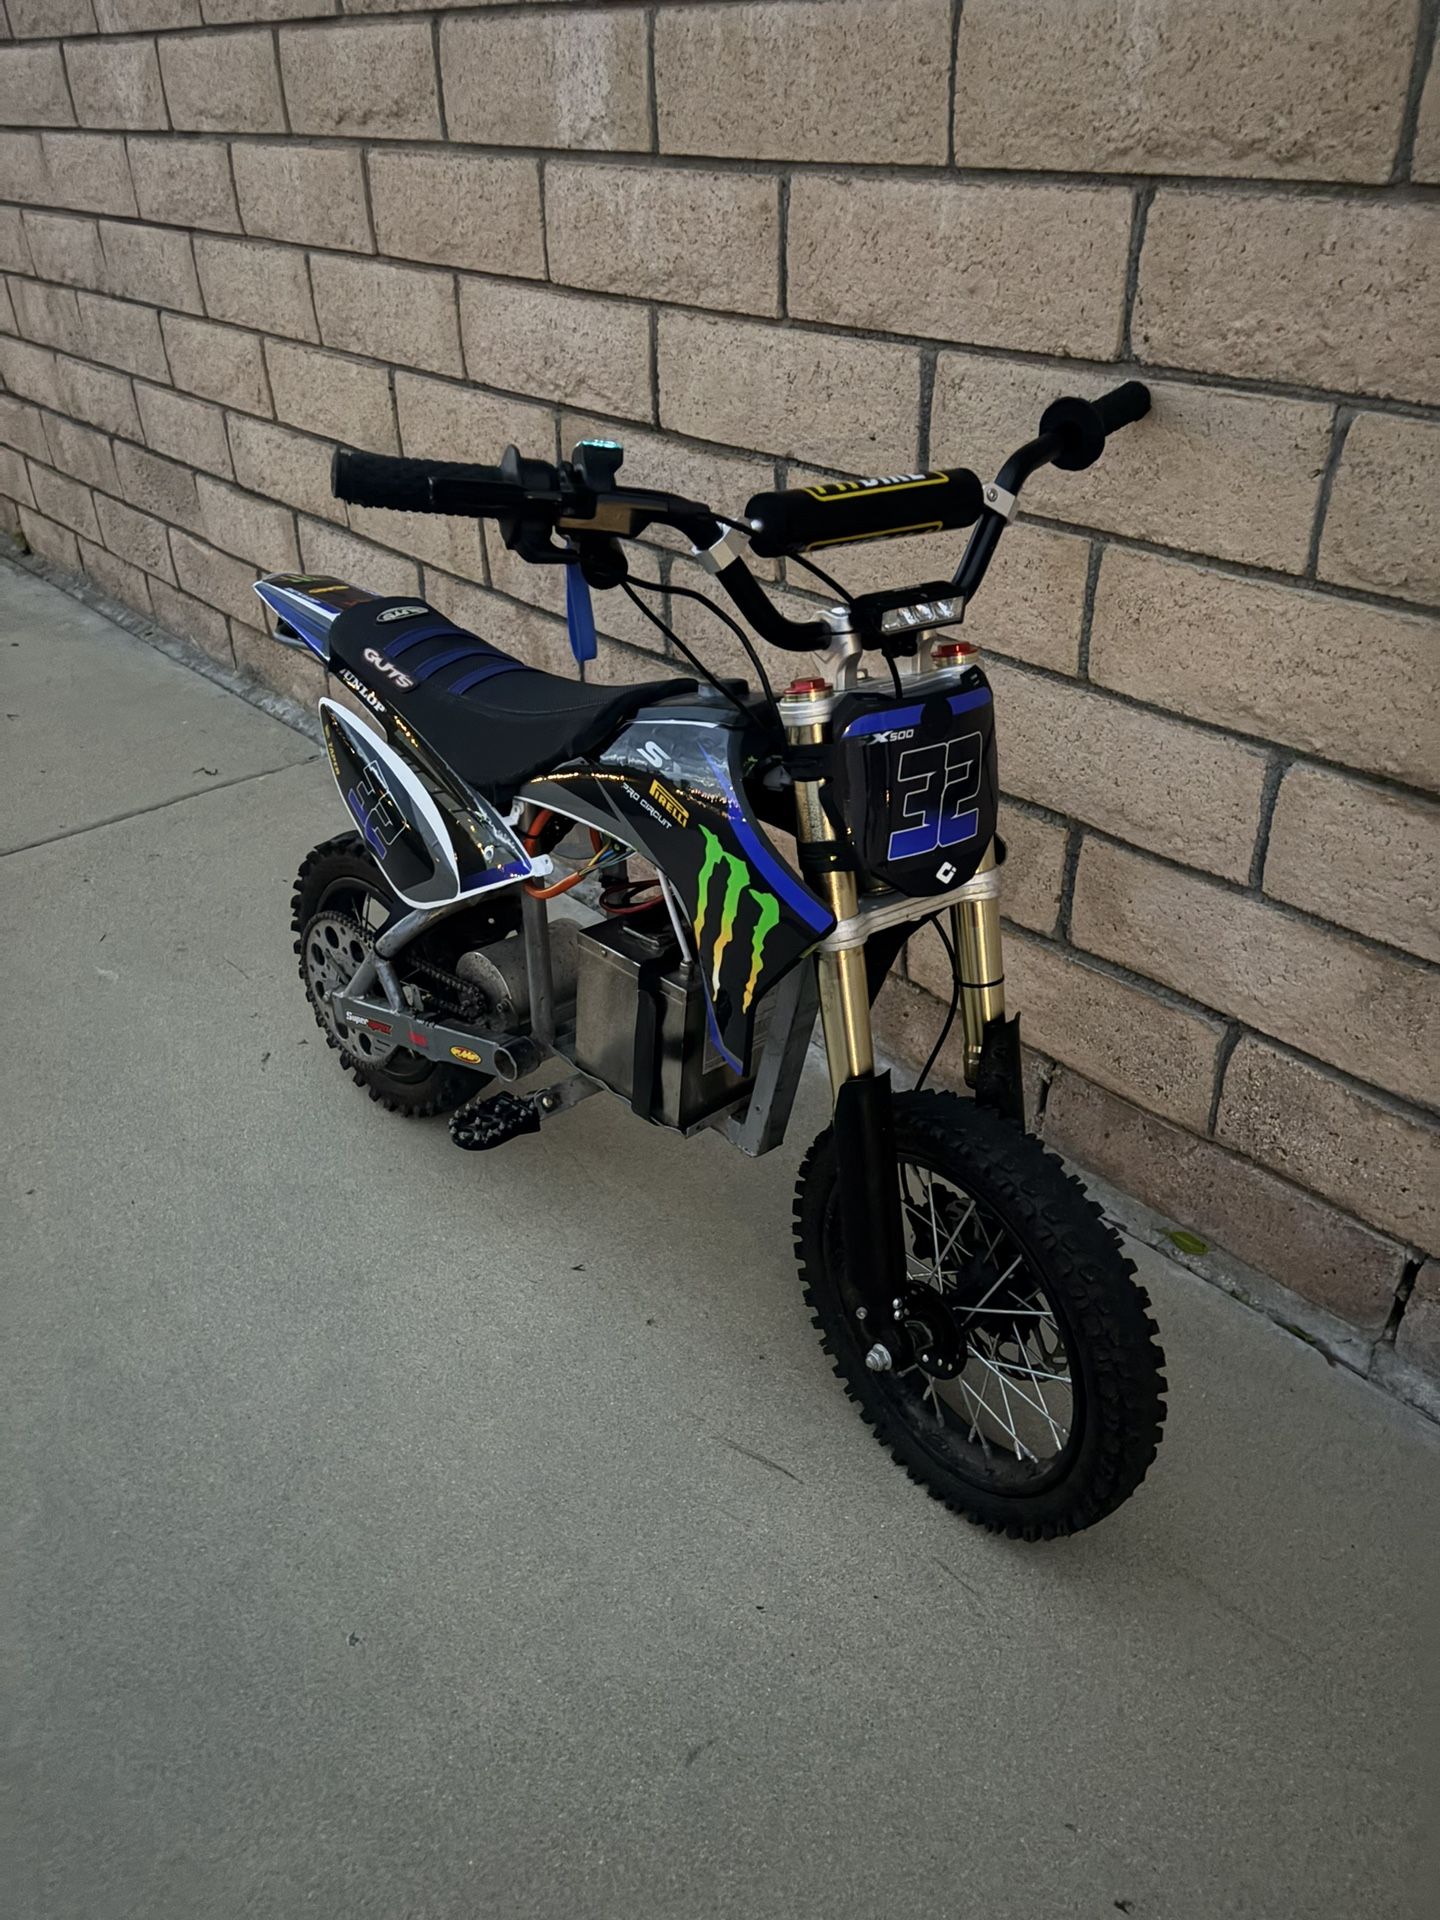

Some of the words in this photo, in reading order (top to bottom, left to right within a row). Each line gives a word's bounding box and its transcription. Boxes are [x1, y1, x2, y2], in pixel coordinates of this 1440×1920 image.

[363, 647, 414, 689] GUTS
[868, 728, 915, 746] X500
[621, 782, 641, 801] PRO
[639, 799, 673, 830] CIRCUIT
[648, 778, 690, 829] PIRELLI
[887, 730, 984, 862] 32
